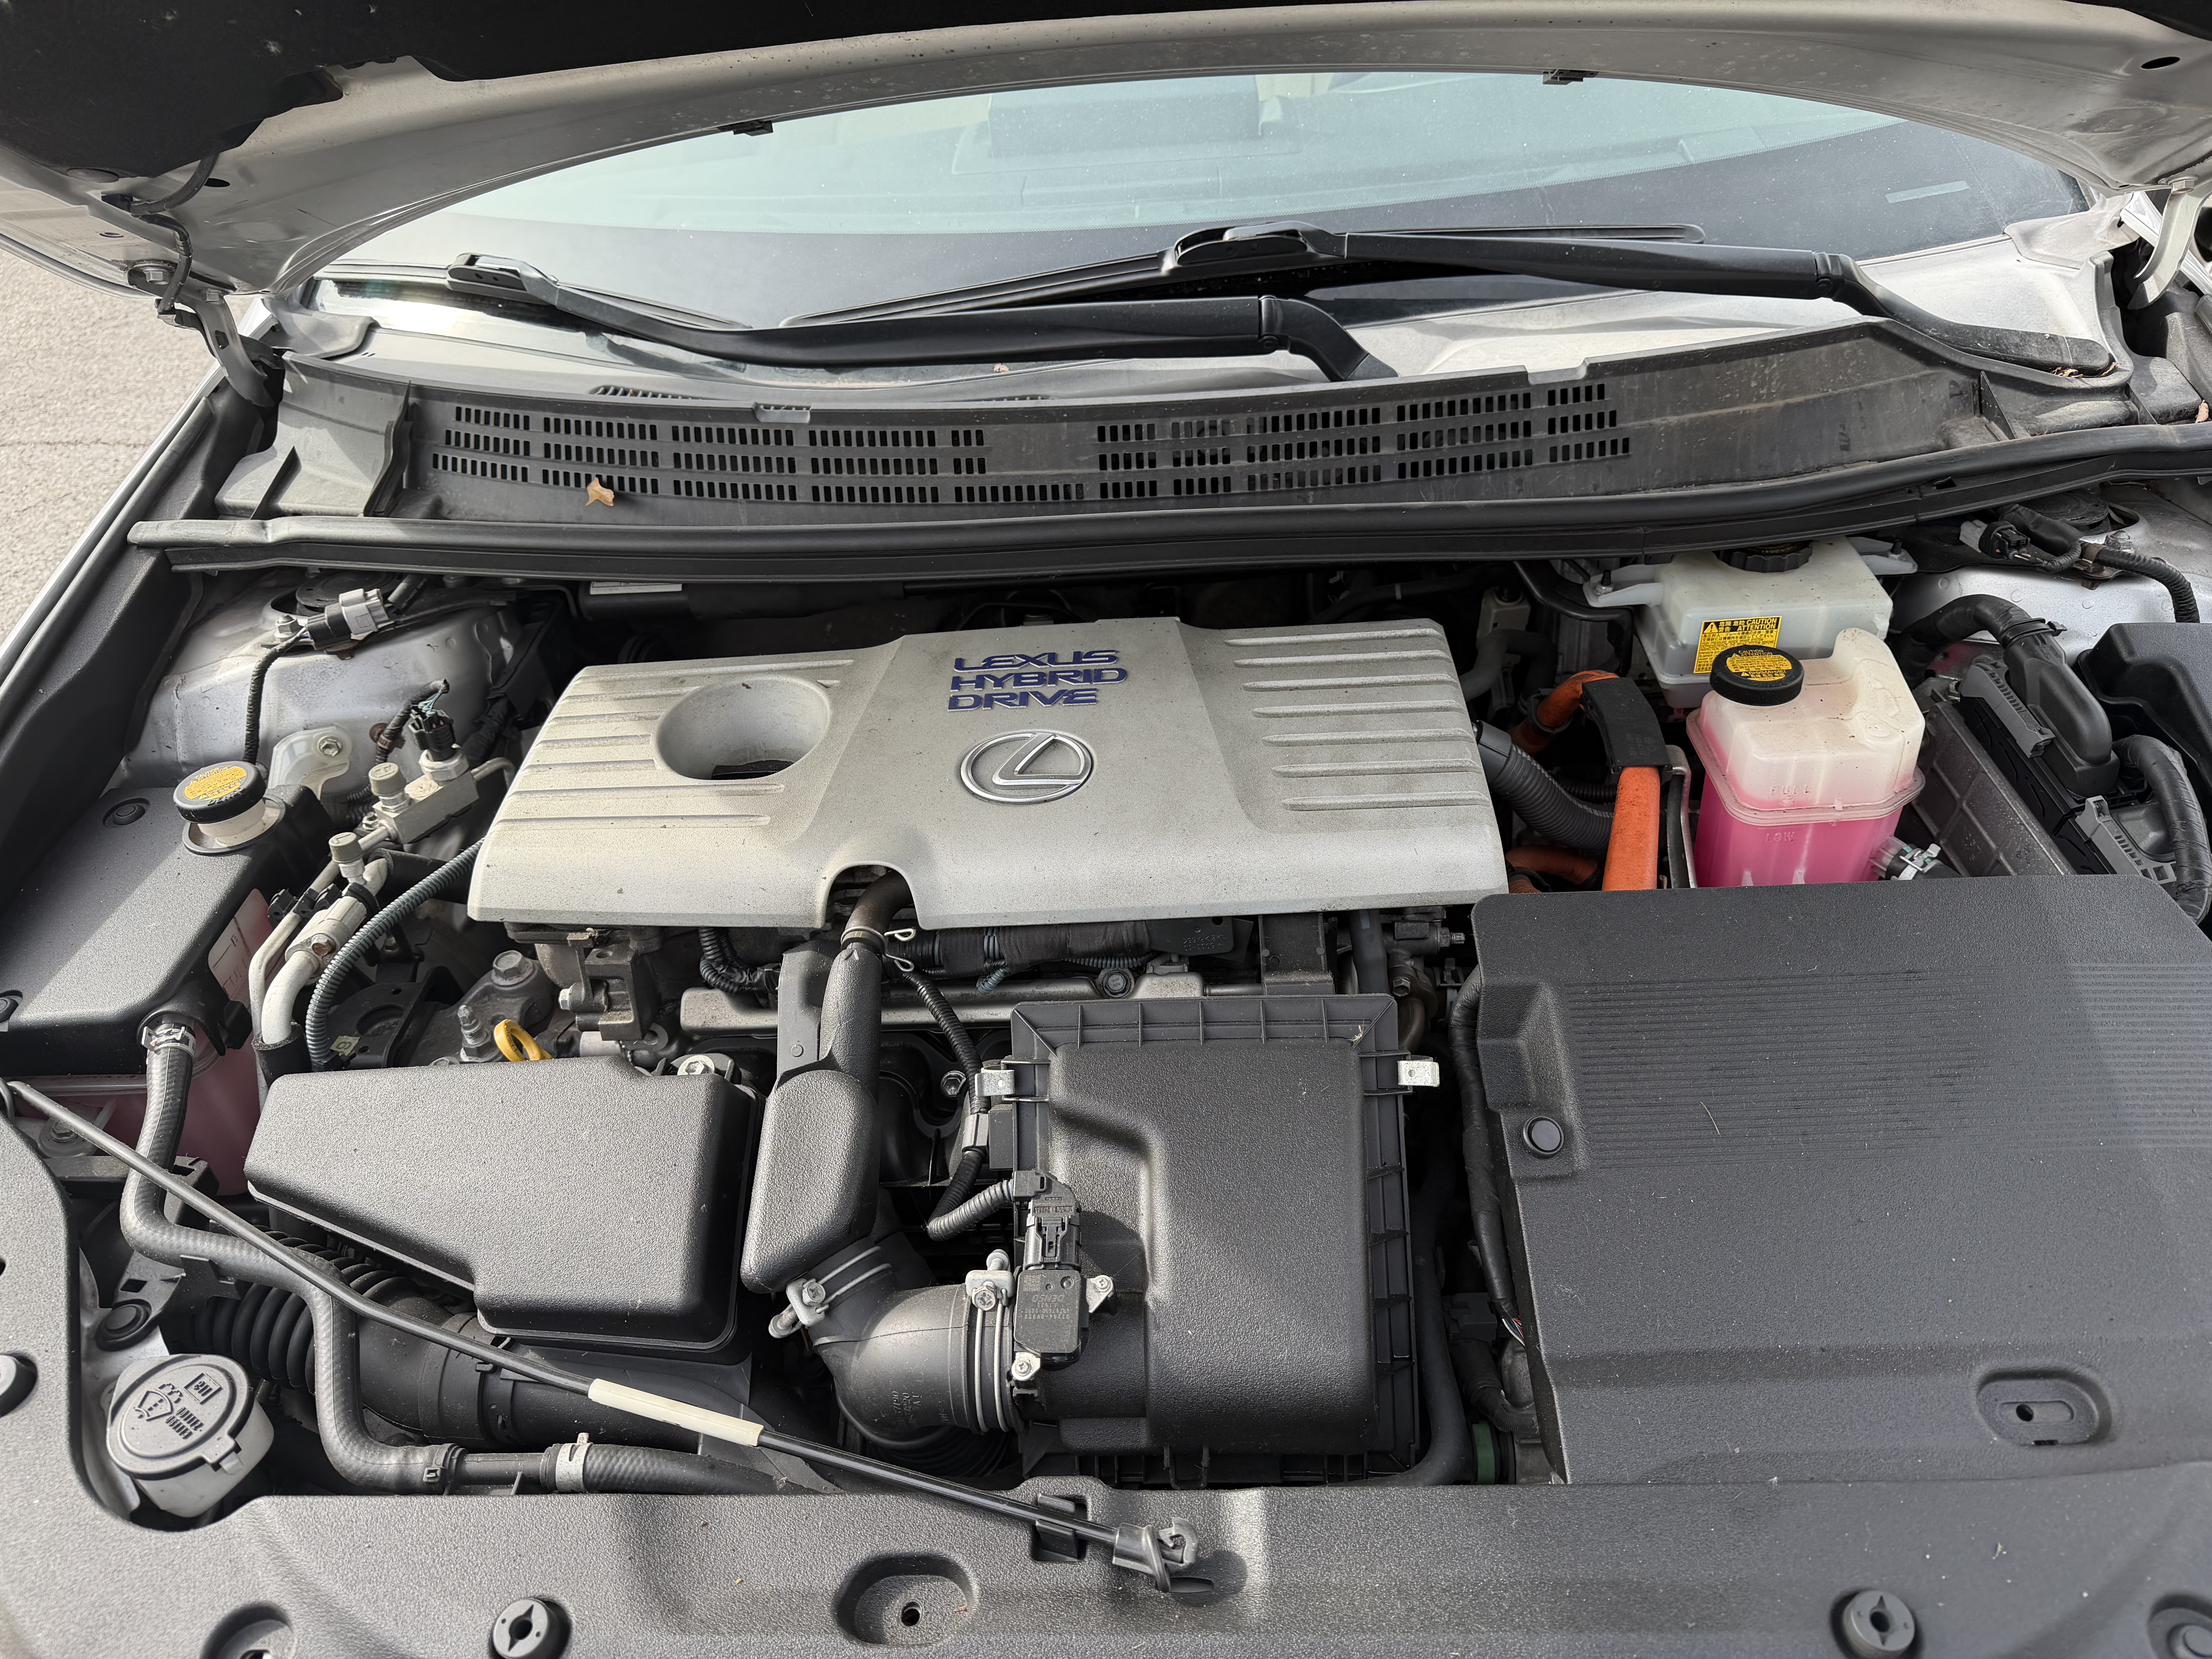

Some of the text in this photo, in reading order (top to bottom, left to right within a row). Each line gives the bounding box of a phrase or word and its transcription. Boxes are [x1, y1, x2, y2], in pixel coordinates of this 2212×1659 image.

[1737, 623, 1776, 632] ATTENTION
[954, 649, 1118, 673] LEXUS
[950, 668, 1127, 692] HYBRID
[947, 688, 1098, 712] DRIVE
[1771, 784, 1810, 795] FULL
[1765, 831, 1795, 843] LOW
[1031, 1294, 1065, 1302] DENSO
